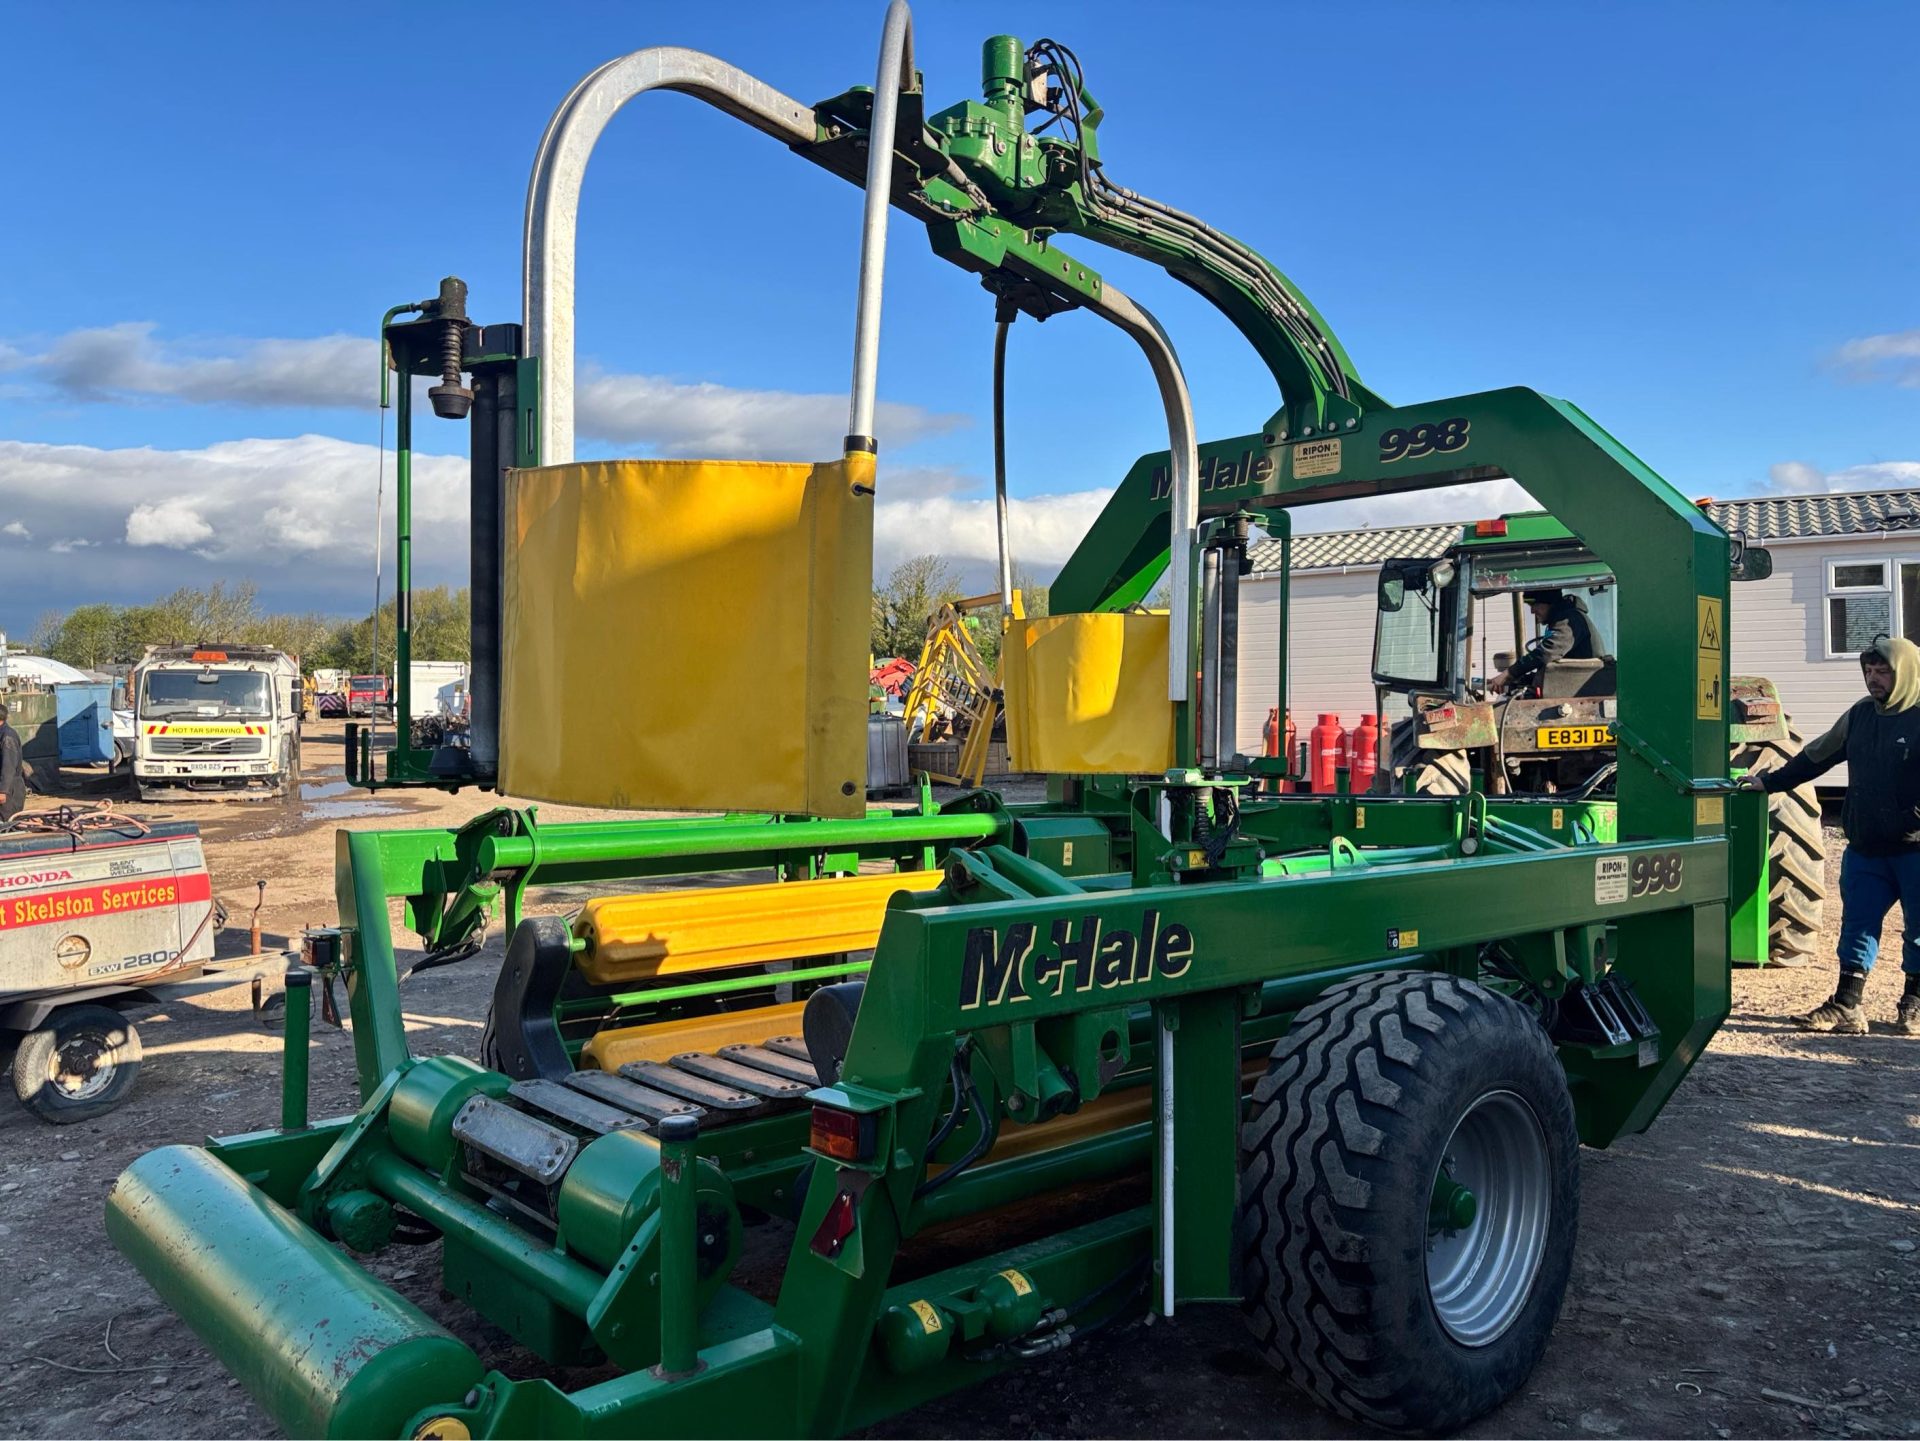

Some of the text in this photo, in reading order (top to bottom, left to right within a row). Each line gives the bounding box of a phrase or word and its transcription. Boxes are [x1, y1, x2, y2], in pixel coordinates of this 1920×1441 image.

[1303, 444, 1330, 455] RIPON
[1379, 417, 1471, 464] 998
[1150, 450, 1275, 501] MHale
[1548, 729, 1588, 745] E831
[110, 867, 143, 876] WELDER
[1602, 861, 1622, 874] RIPON
[1631, 852, 1684, 898] 998
[0, 870, 73, 888] HONDA
[15, 897, 94, 924] Skelston
[102, 884, 176, 911] Services
[959, 908, 1195, 1011] McHale
[89, 963, 121, 976] EXW
